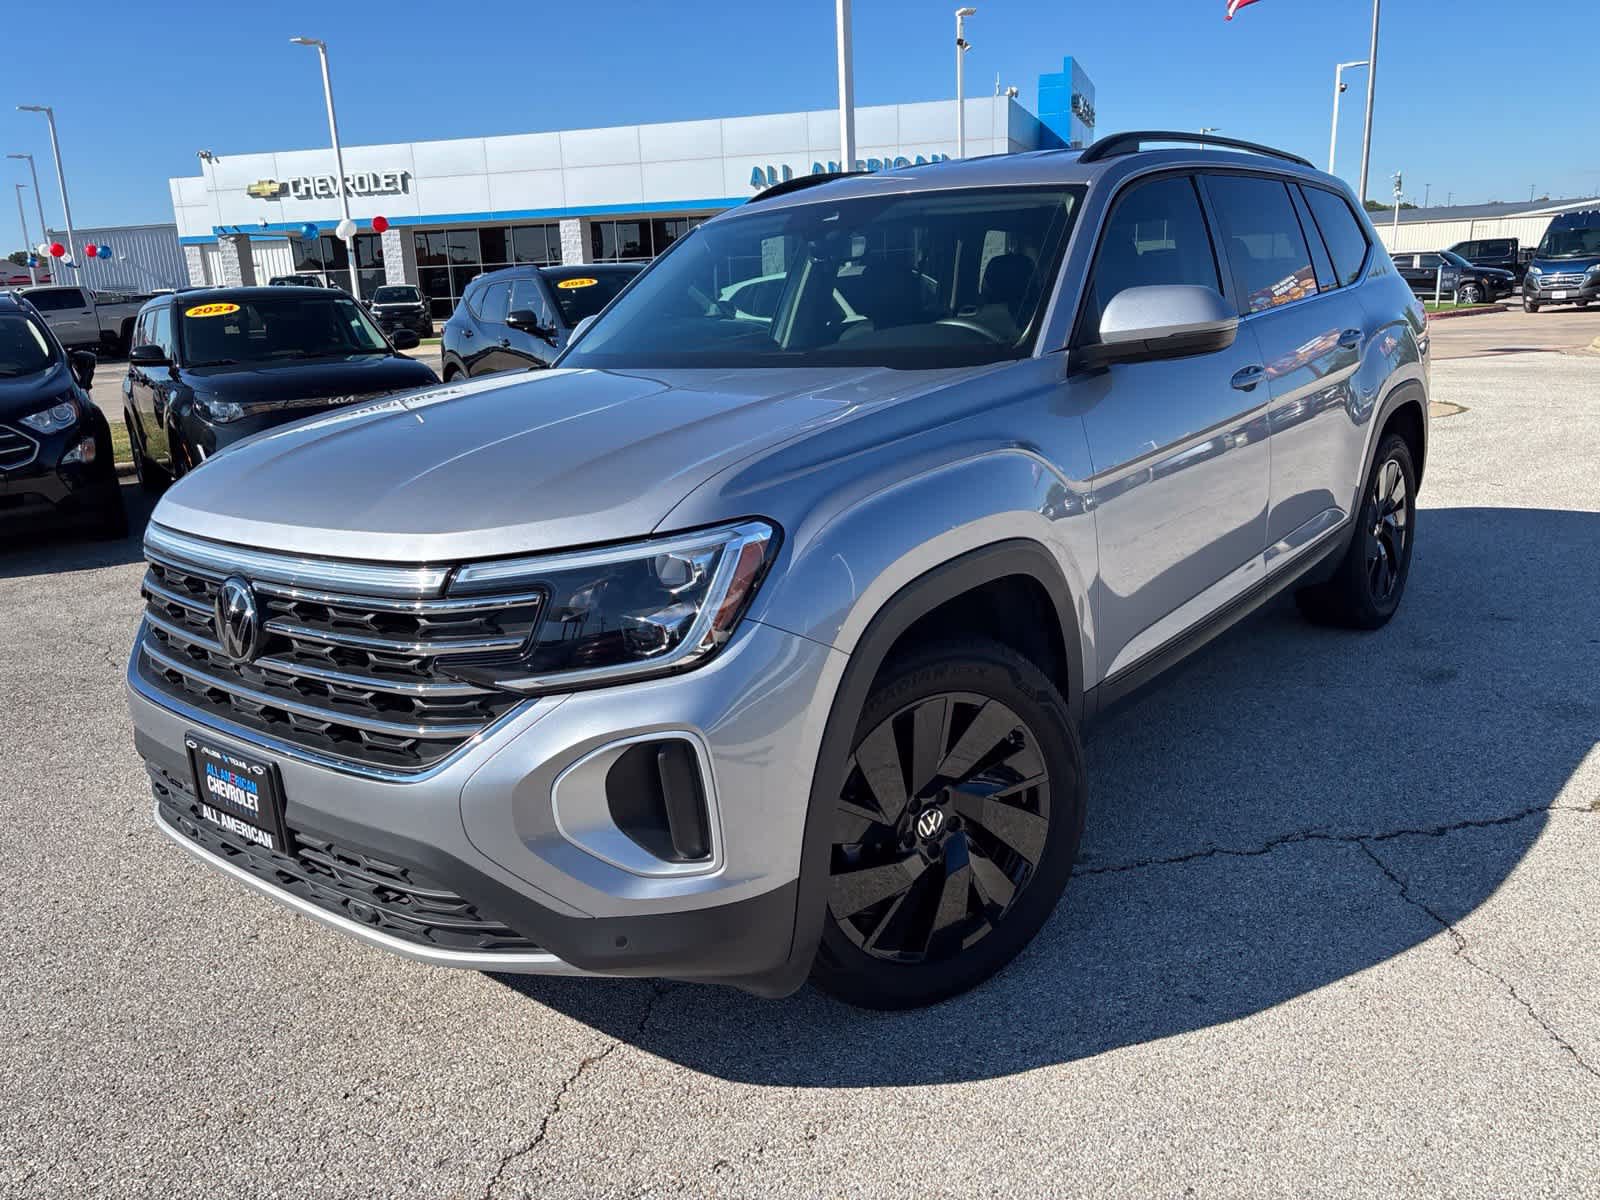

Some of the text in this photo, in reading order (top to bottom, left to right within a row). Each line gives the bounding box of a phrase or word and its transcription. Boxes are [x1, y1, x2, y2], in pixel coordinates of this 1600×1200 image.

[288, 170, 412, 199] CHEVROLET
[750, 165, 793, 189] ALL
[192, 305, 234, 316] 2024
[328, 395, 354, 405] KIA
[206, 762, 258, 794] ALL AMERICAN
[207, 774, 259, 812] CHEVROLET
[202, 804, 221, 825] ALL
[221, 813, 273, 849] AMERICAN
